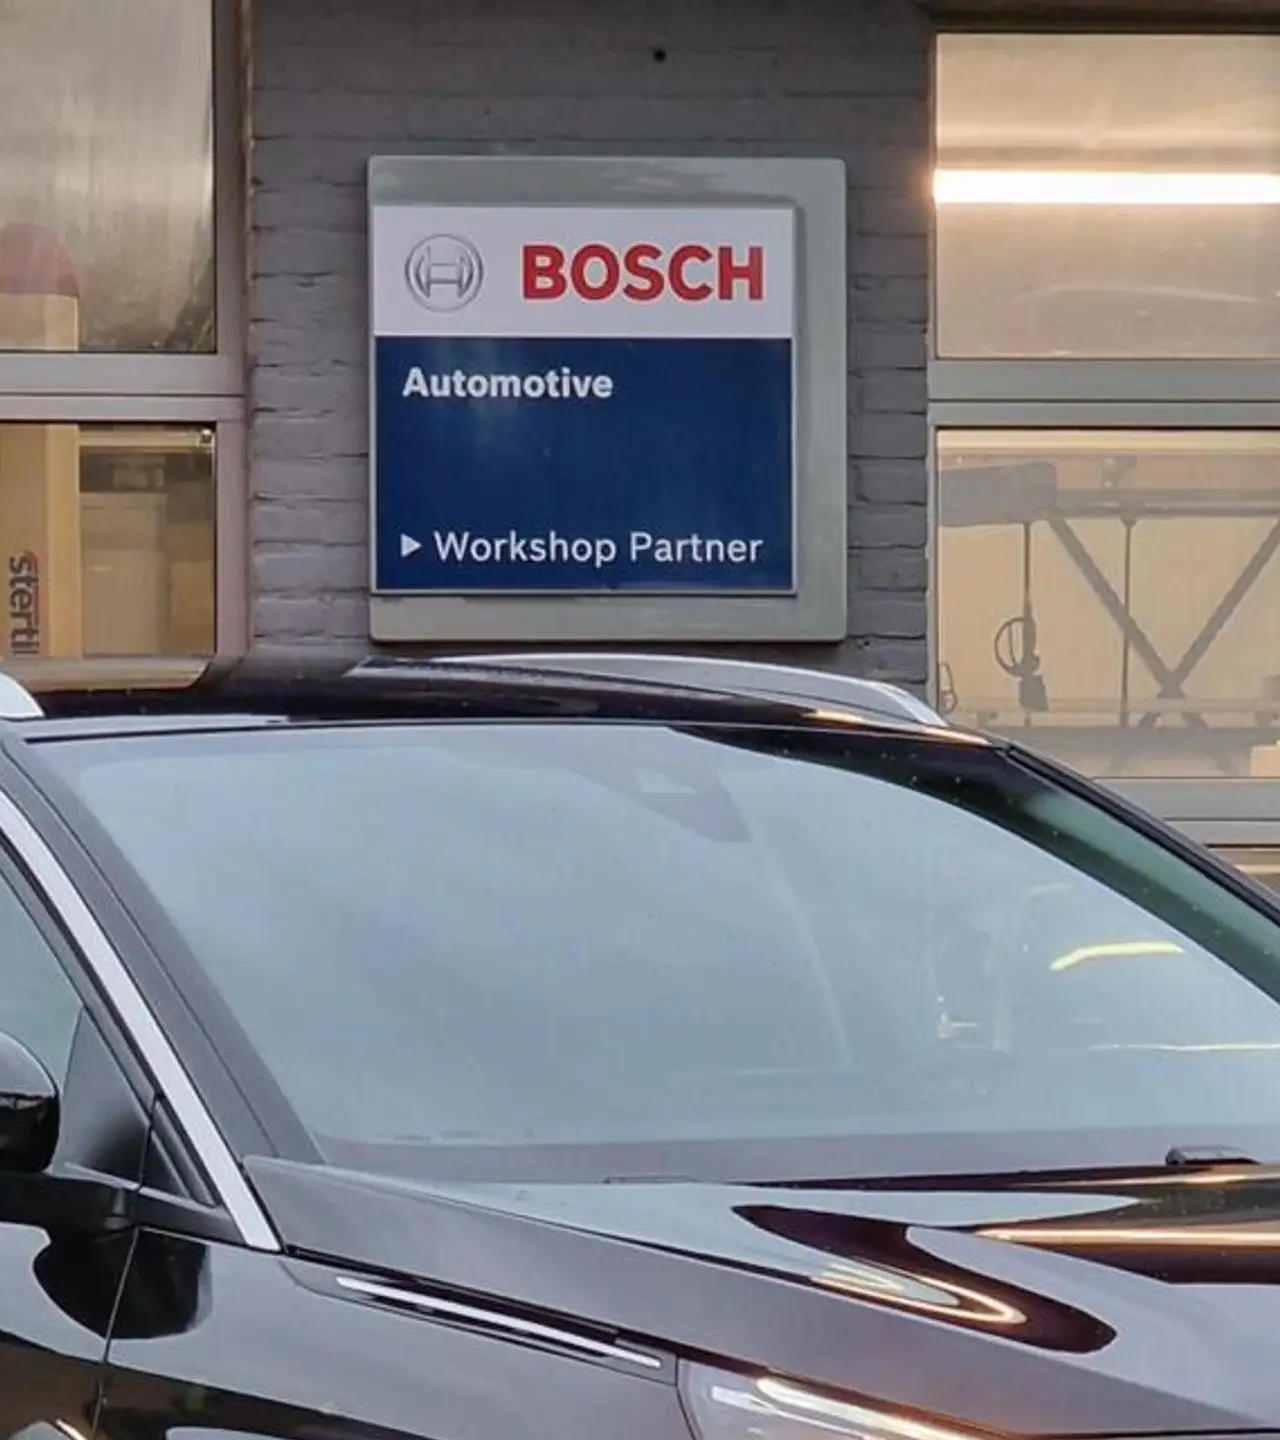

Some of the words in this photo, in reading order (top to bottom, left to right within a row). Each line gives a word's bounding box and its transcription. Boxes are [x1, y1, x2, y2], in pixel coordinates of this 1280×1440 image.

[521, 243, 764, 301] BOSCH
[402, 367, 615, 399] Automotive
[434, 530, 617, 567] Workshop
[629, 531, 764, 563] Partner
